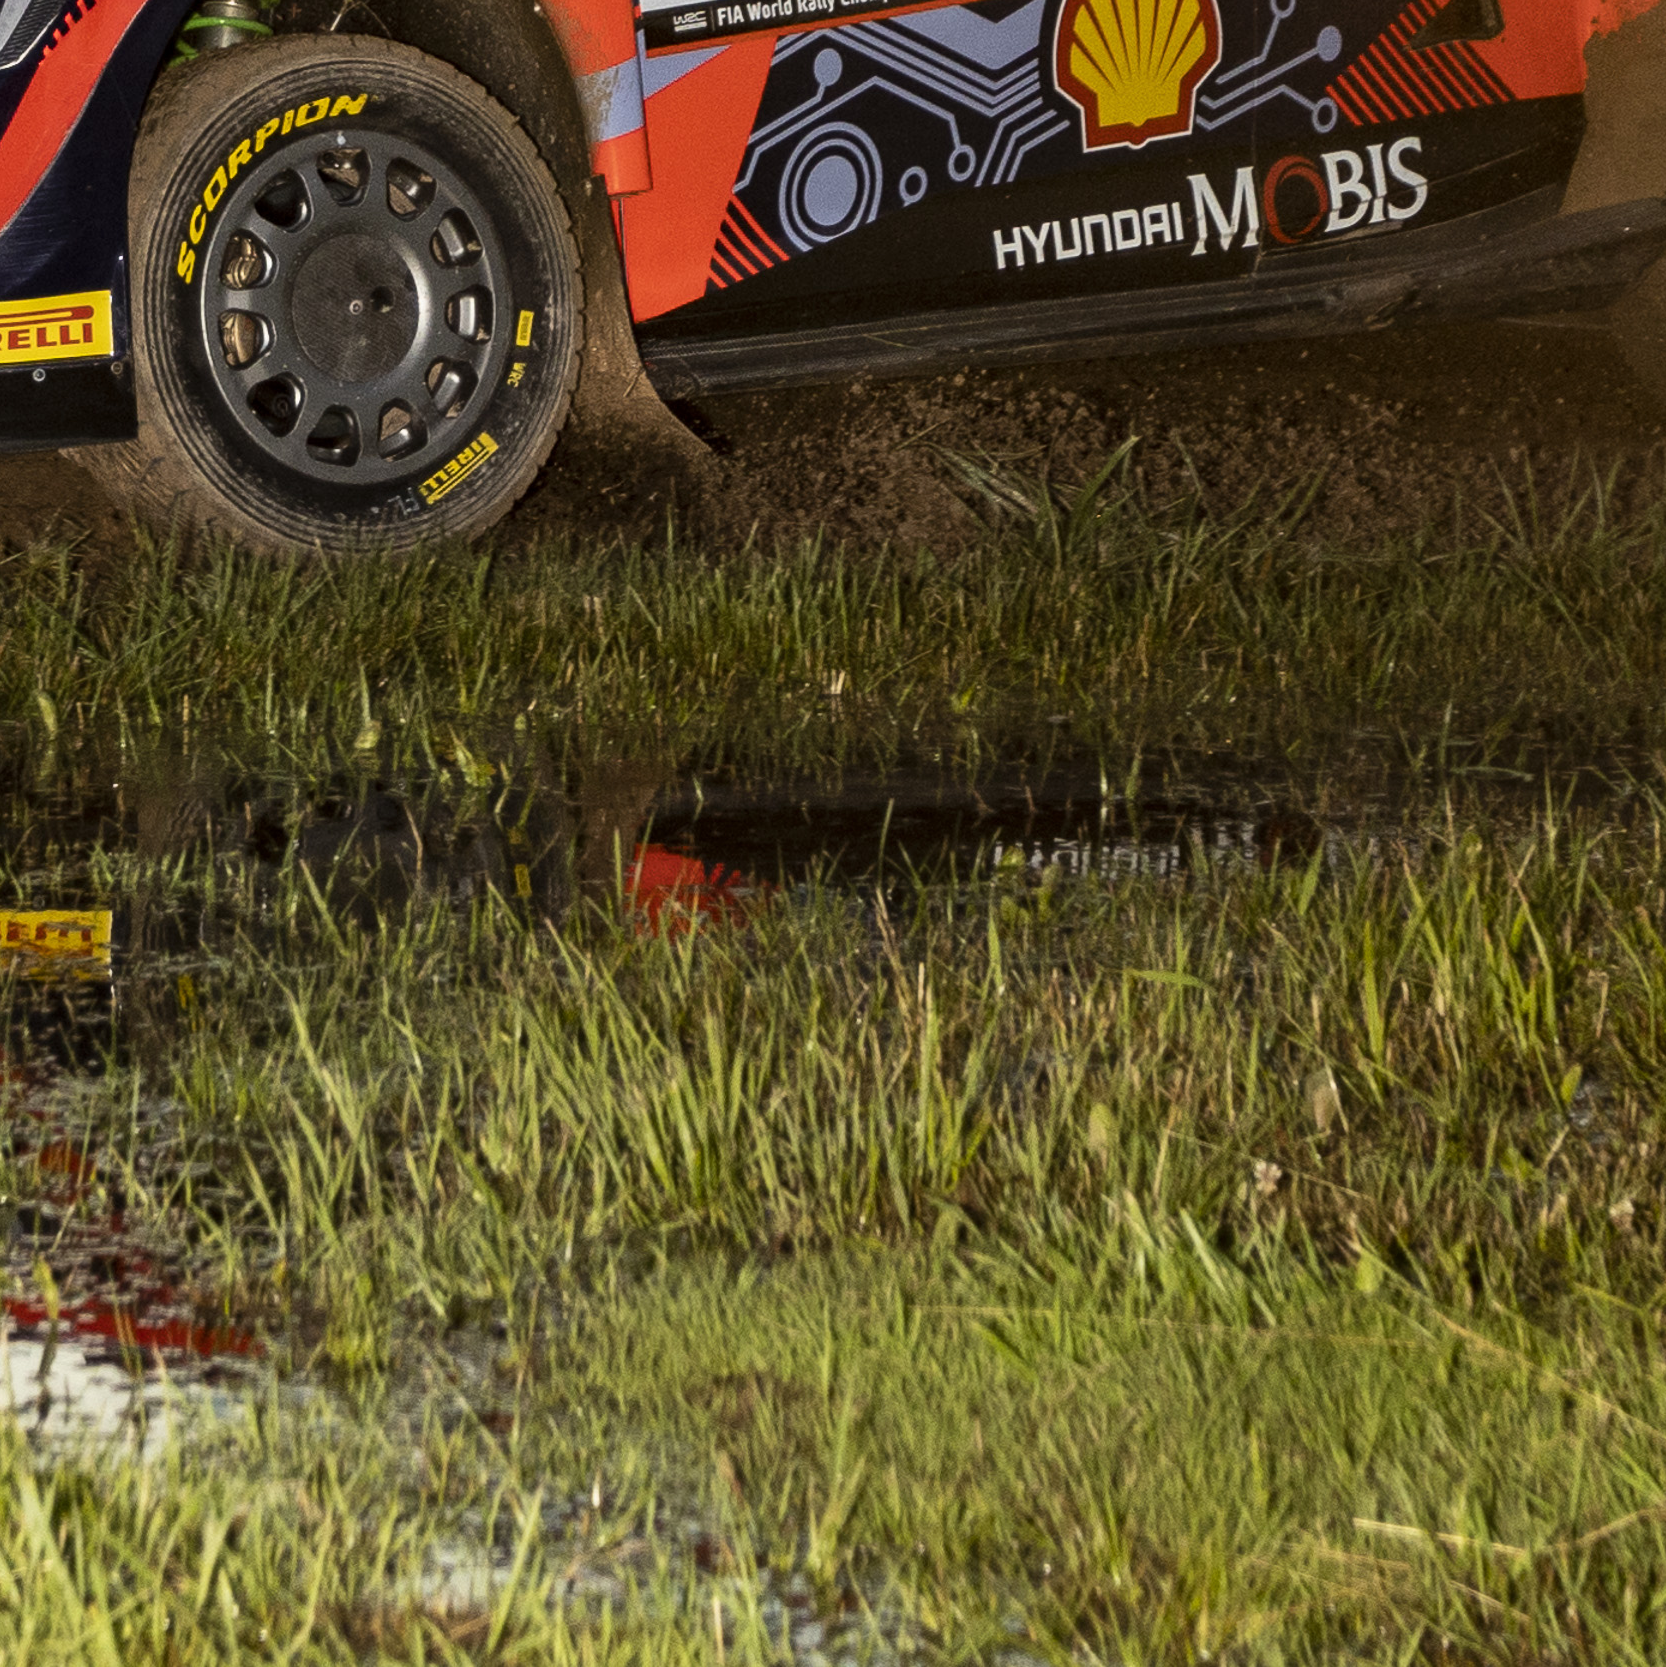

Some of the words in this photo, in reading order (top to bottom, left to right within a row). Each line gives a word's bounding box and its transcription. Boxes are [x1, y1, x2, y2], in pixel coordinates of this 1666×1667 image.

[717, 5, 744, 26] FIA
[178, 92, 369, 284] SCORPION
[993, 201, 1185, 269] HYUNDAI
[1186, 136, 1428, 256] MOBIS
[419, 432, 499, 505] PIRELLI
